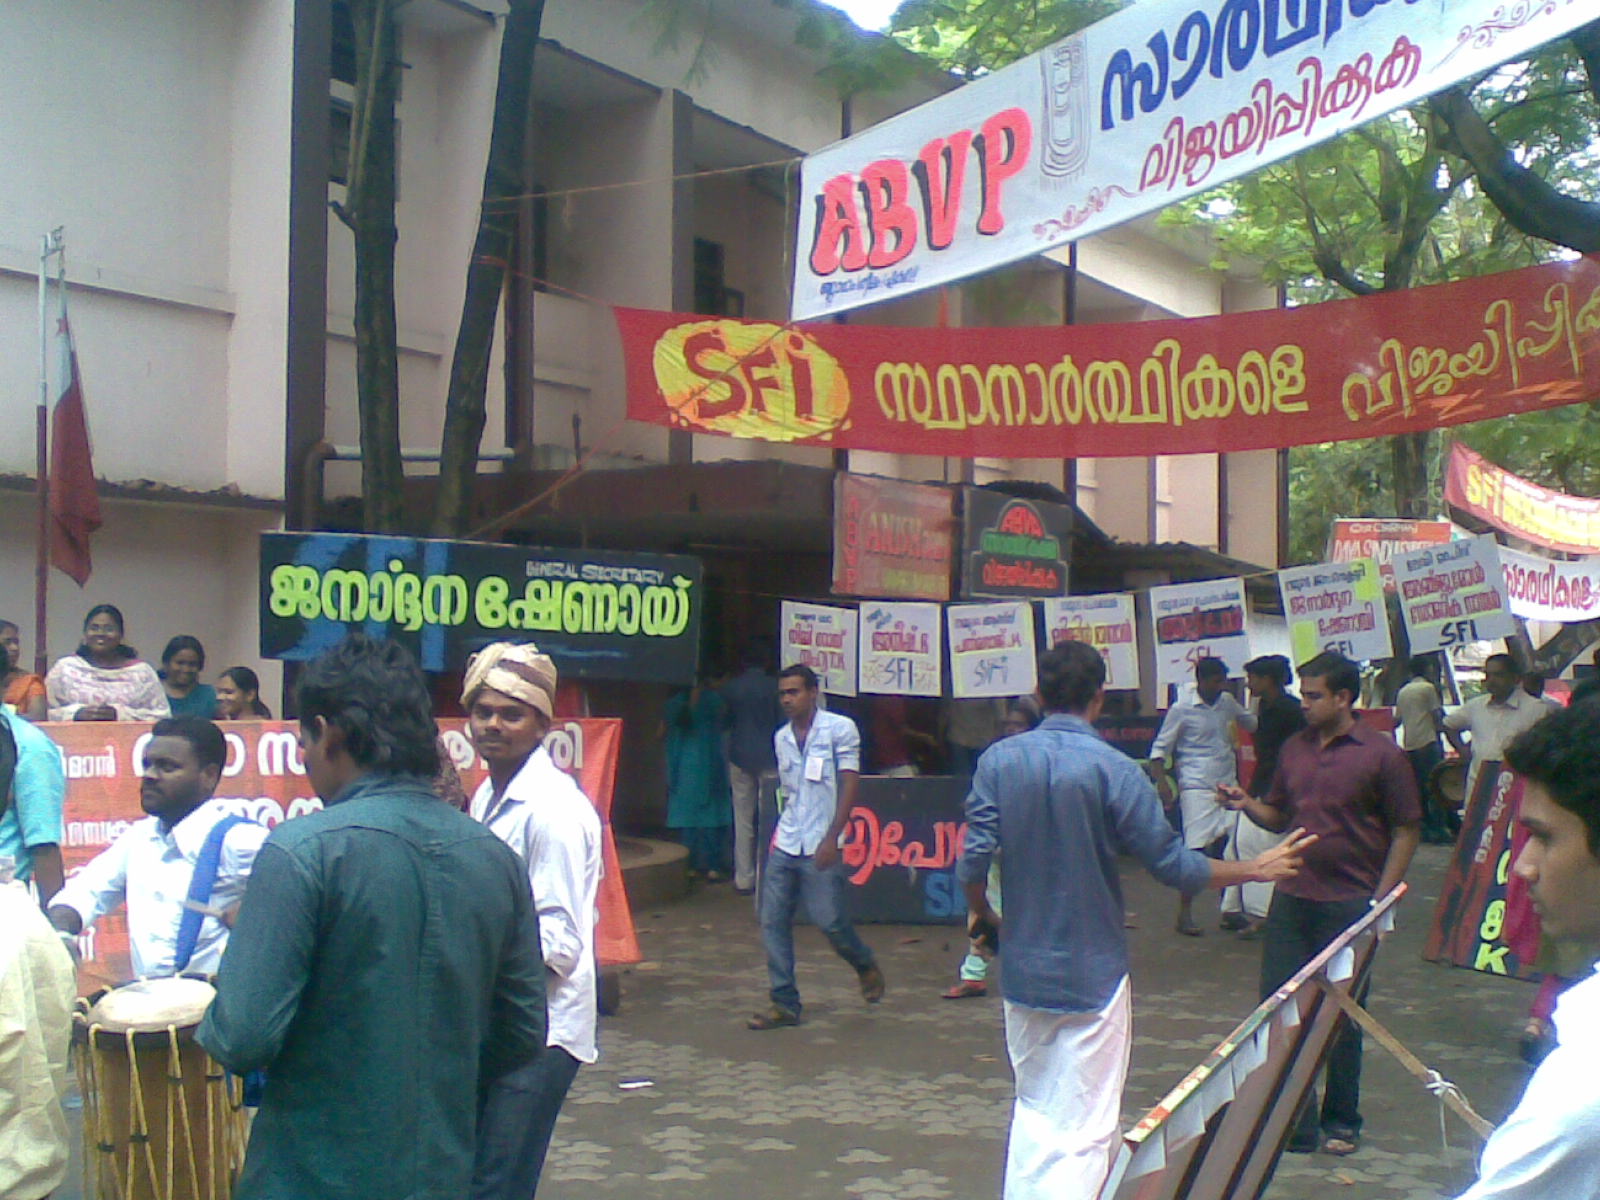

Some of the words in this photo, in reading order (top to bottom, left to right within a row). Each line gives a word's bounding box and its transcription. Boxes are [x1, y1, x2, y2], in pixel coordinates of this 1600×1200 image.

[810, 106, 1034, 276] ABVP
[1438, 619, 1479, 647] SFI
[884, 657, 914, 690] SFI
